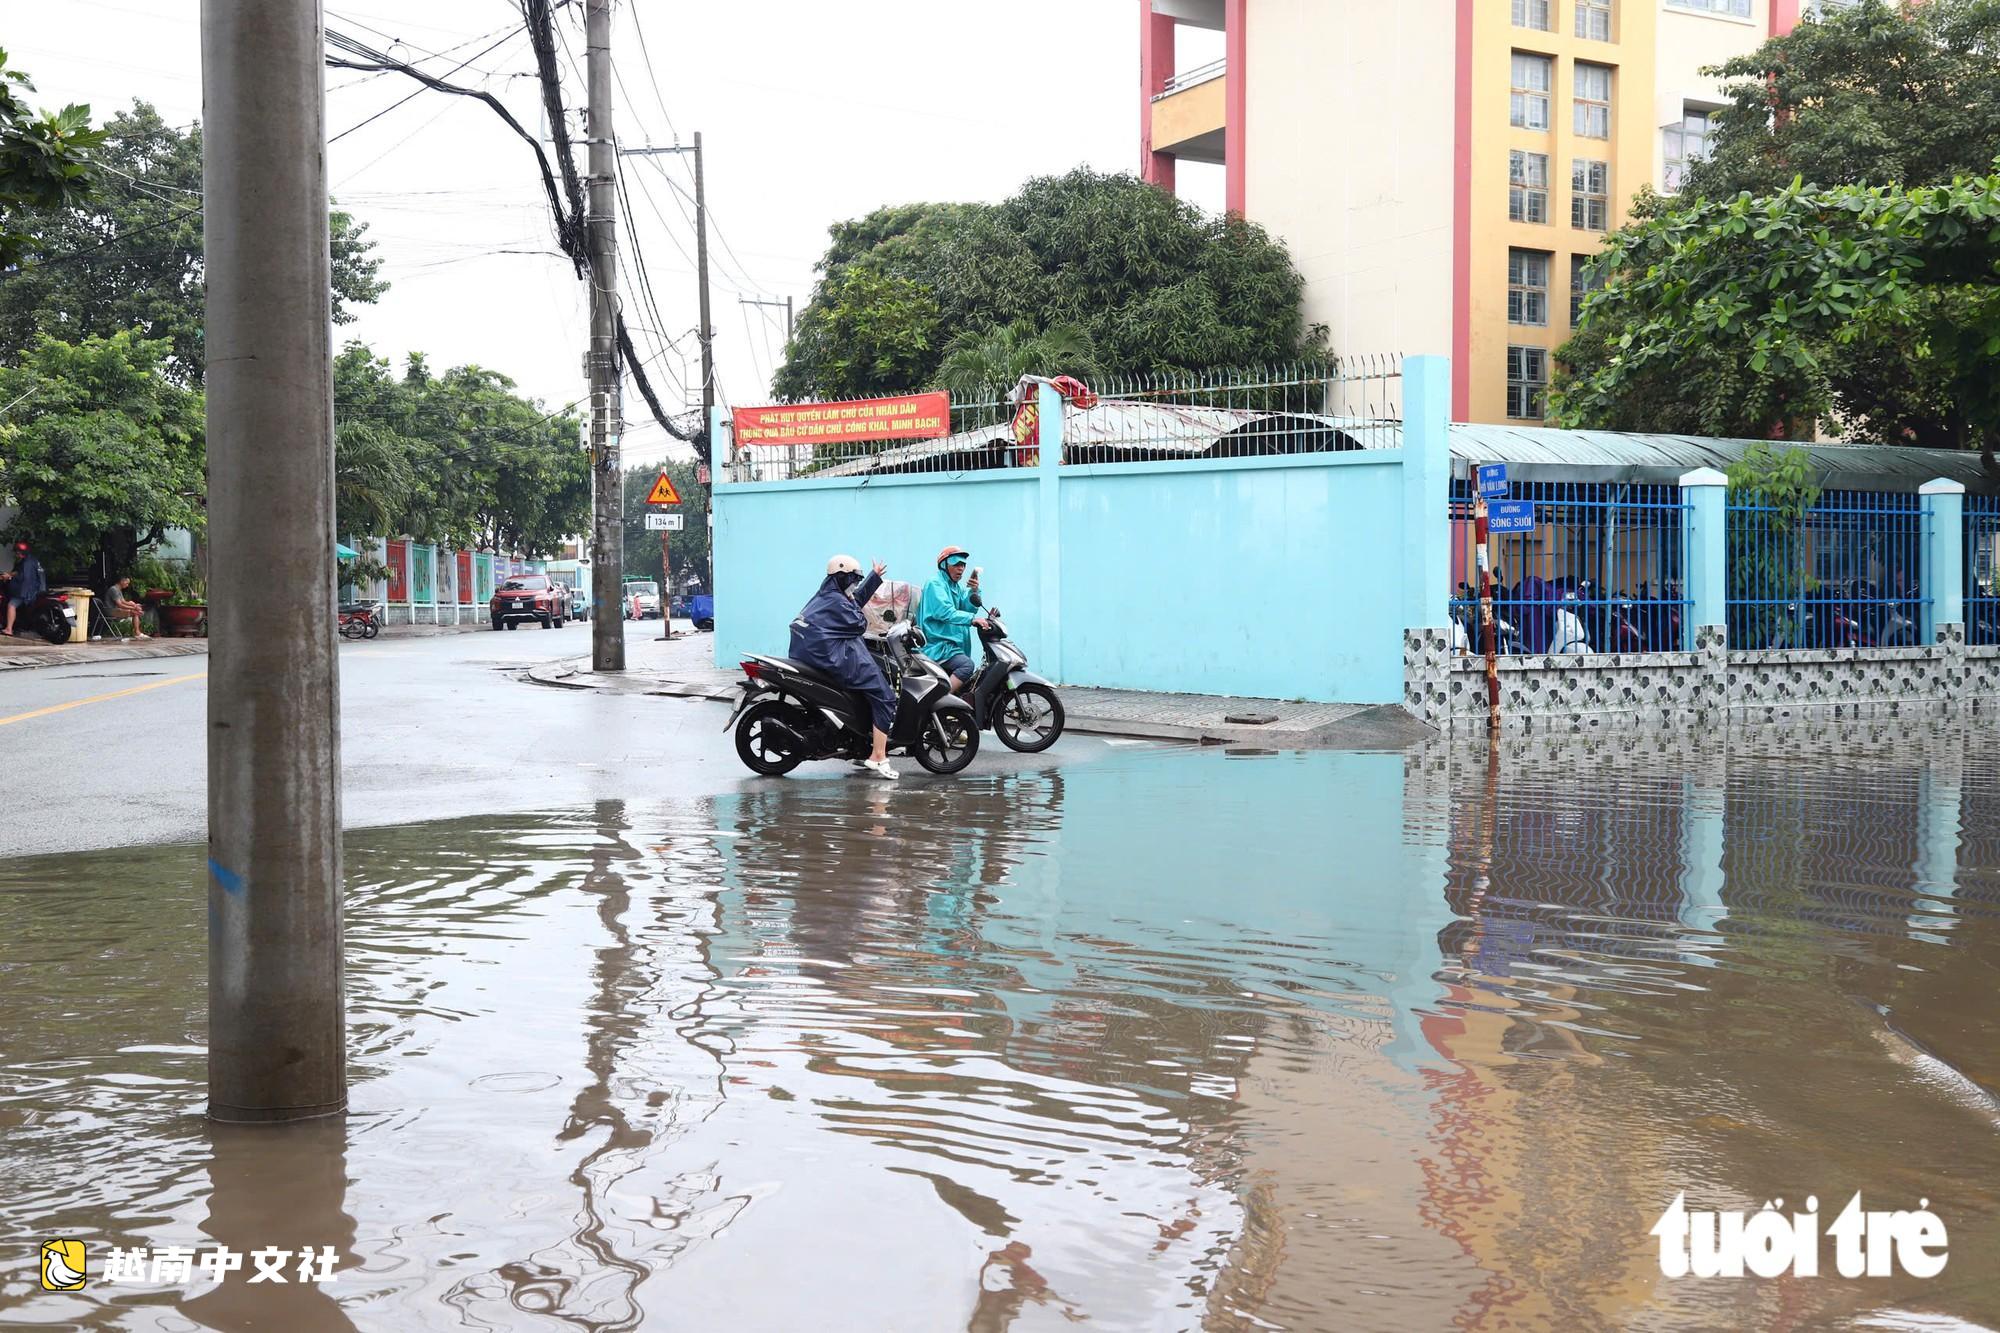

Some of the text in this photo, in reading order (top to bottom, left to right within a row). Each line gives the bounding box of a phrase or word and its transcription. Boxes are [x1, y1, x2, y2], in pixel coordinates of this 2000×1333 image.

[760, 412, 779, 424] PHÁT
[780, 412, 795, 423] HUY
[823, 408, 839, 420] LÀM
[841, 405, 857, 418] CHỦ
[858, 404, 874, 418] CỦA
[876, 402, 898, 416] NHÂN
[899, 401, 917, 415] DÂN
[740, 427, 763, 439] THÔNG
[764, 427, 779, 438] QUA
[808, 423, 824, 436] DÂN
[845, 420, 867, 433] CÔNG
[891, 418, 913, 431] MINH
[915, 416, 940, 431] BẠCH!
[655, 518, 667, 526] 134
[1514, 513, 1532, 527] SUỐI
